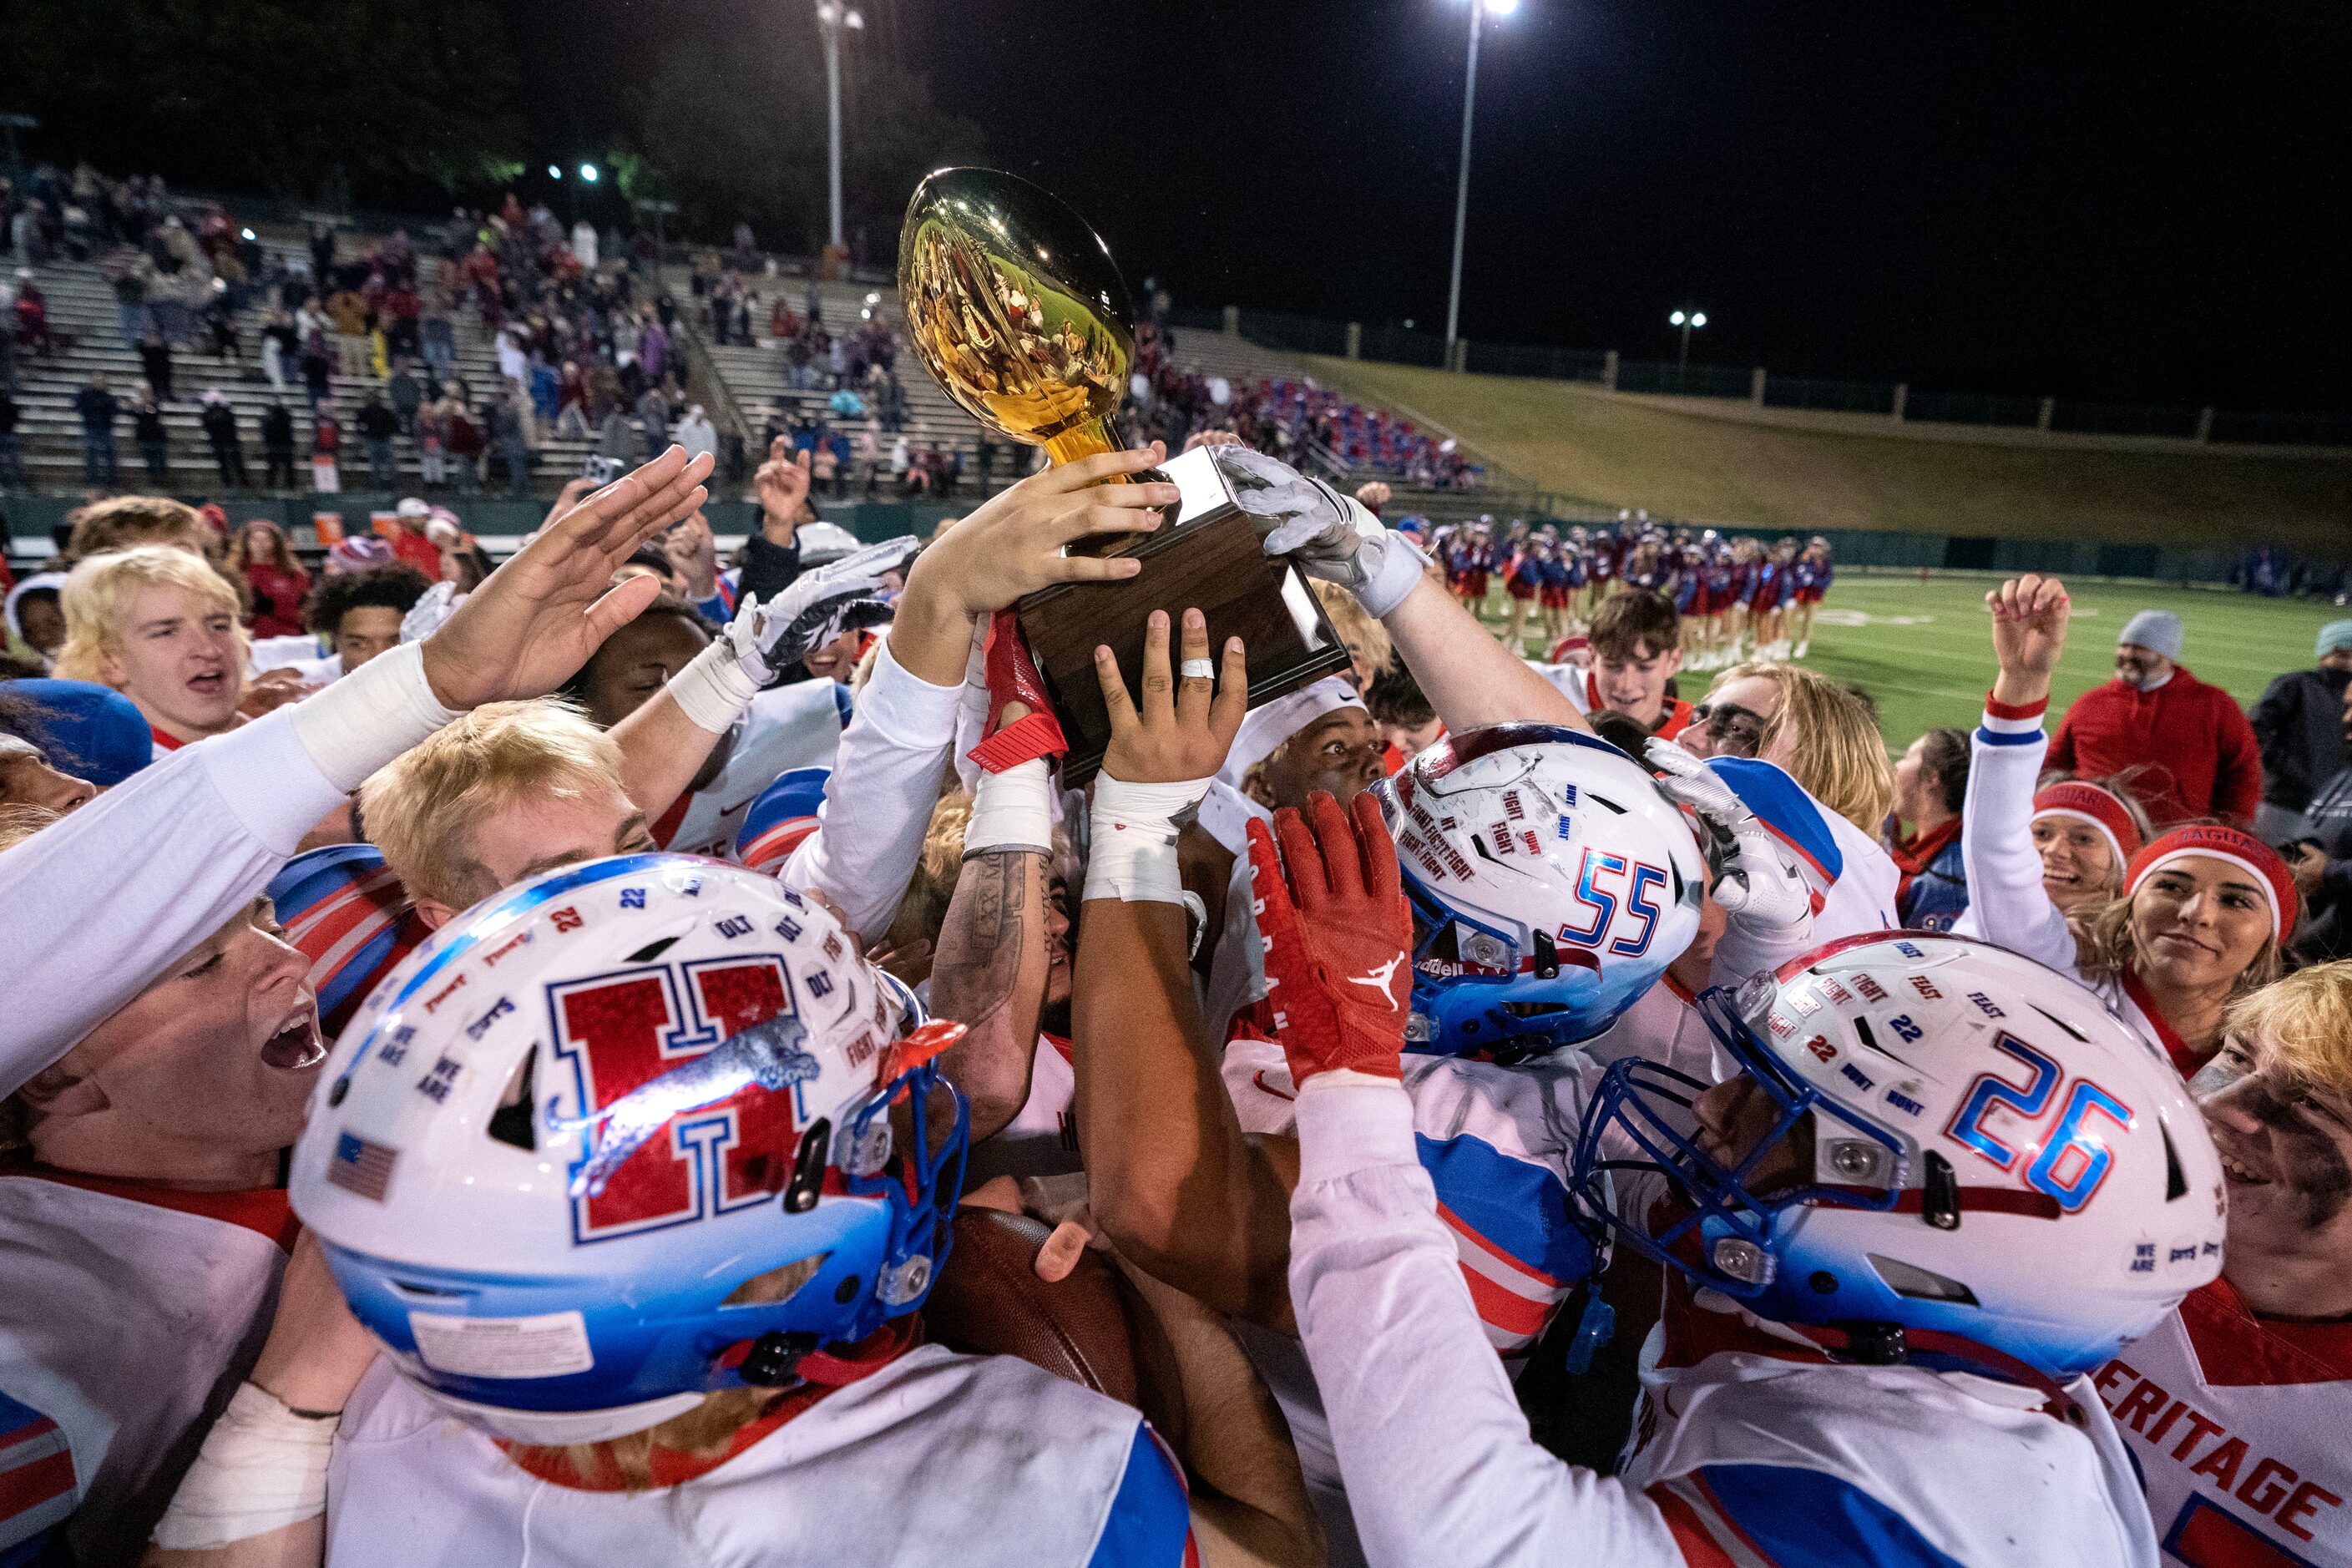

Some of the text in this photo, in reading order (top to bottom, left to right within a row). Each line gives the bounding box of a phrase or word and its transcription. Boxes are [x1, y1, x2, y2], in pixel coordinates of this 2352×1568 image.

[1502, 790, 1525, 822] FIGHT
[1565, 783, 1577, 807] HUNT
[1491, 821, 1515, 855] FIGHT
[1524, 829, 1542, 856] HUNT
[1558, 815, 1571, 841] HUNT
[1444, 847, 1476, 883] FIGHT
[620, 888, 646, 909] 22
[1555, 846, 1668, 959] 55
[1415, 959, 1464, 977] iddell
[1849, 972, 1890, 1004] FIGHT
[1907, 975, 1945, 1000] FEAST
[1966, 991, 2007, 1019] FEAST
[1888, 1014, 1925, 1044] 22
[1806, 1034, 1838, 1064] 22
[1942, 1029, 2136, 1216] 26
[2092, 1358, 2344, 1543] ERITAGE
